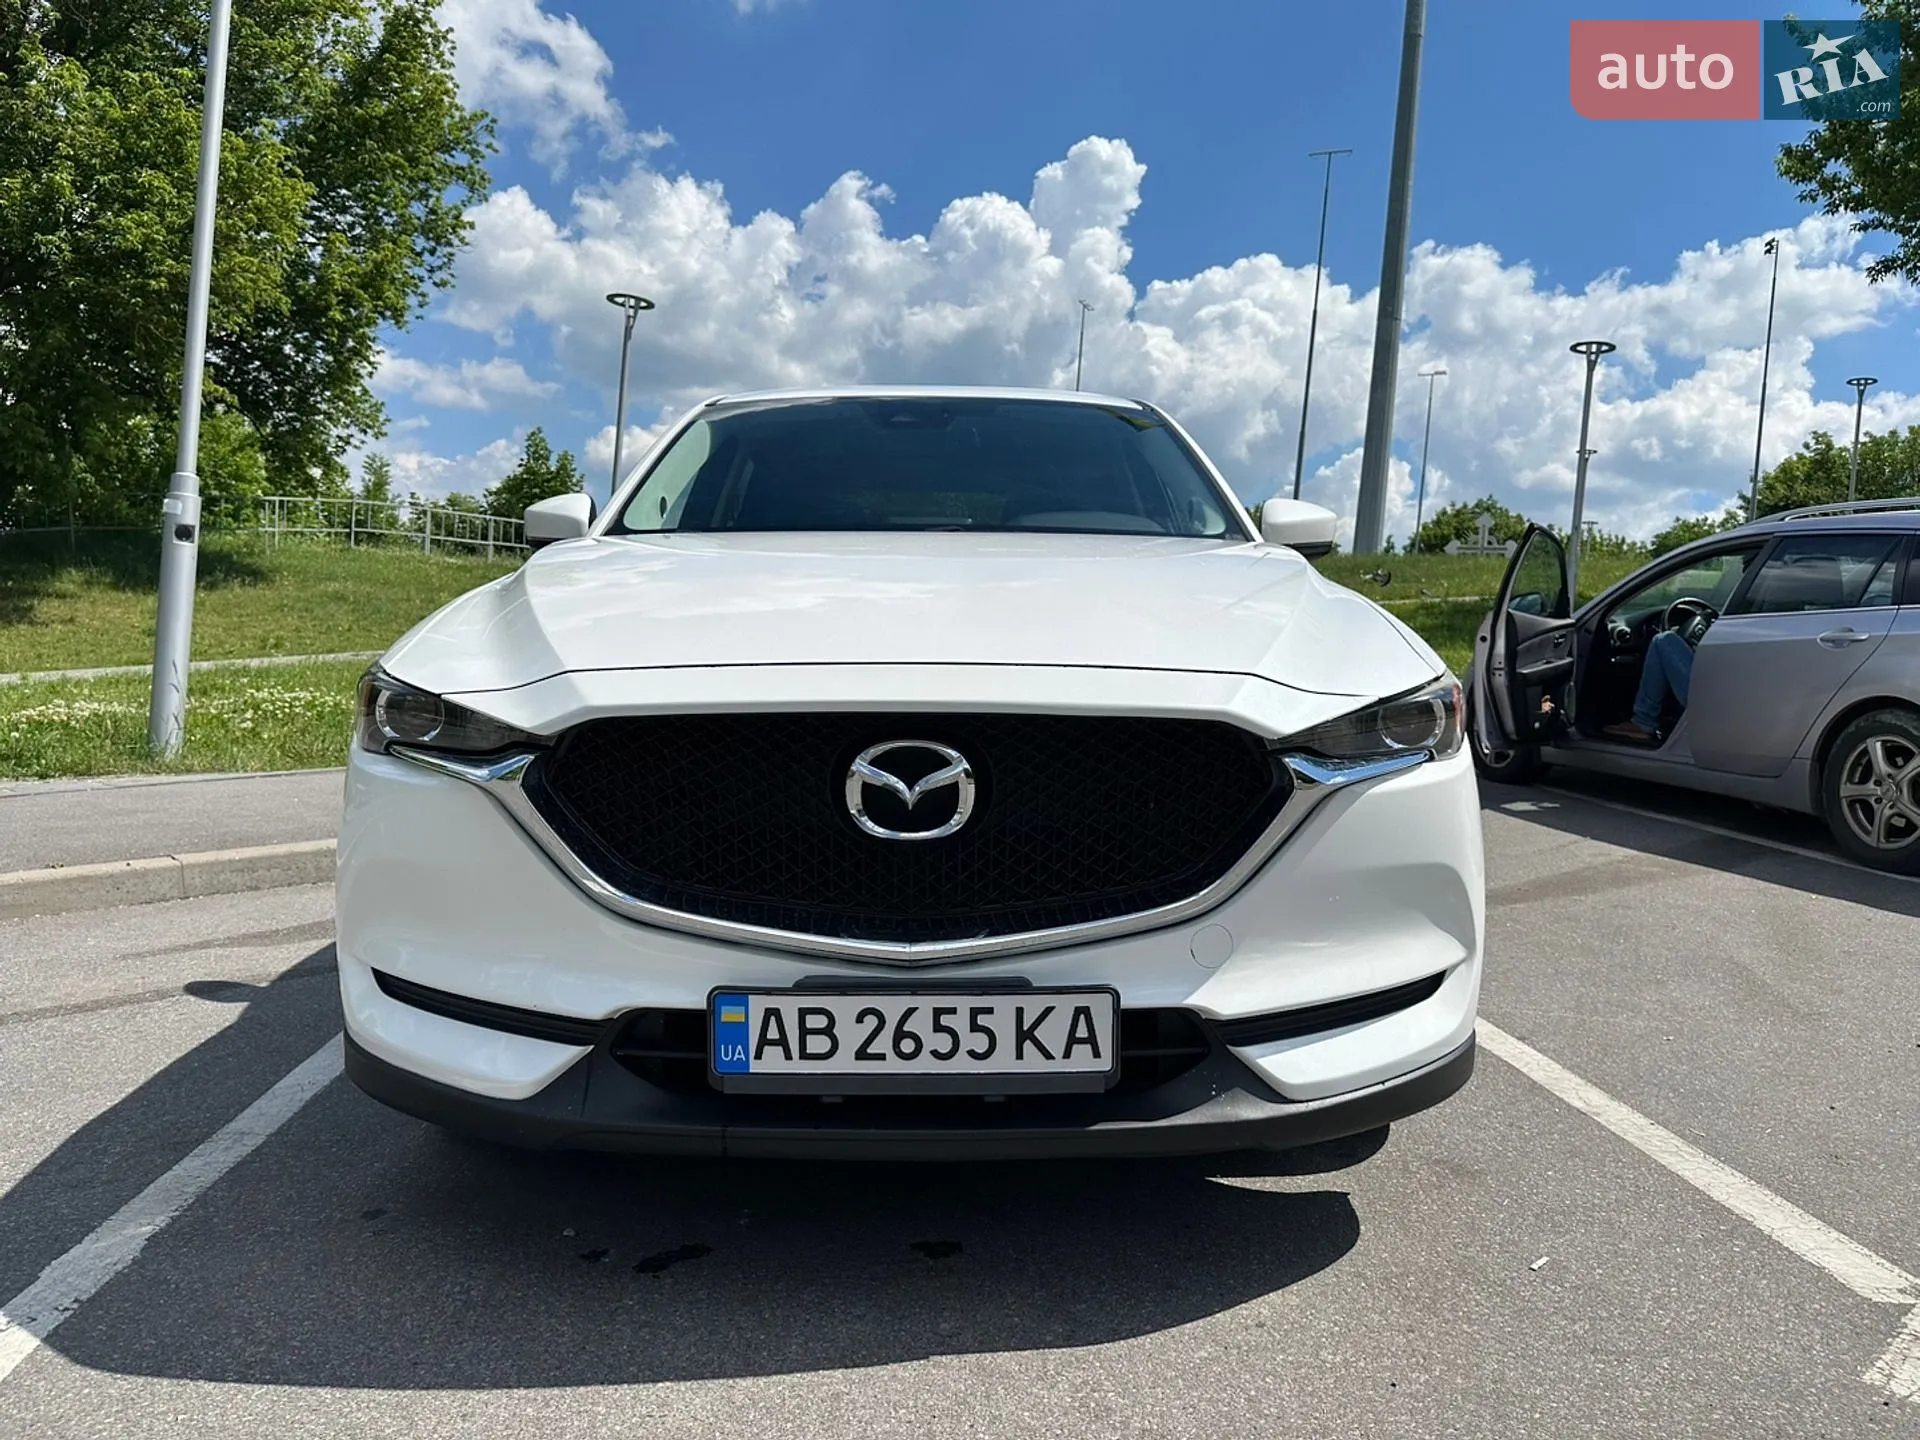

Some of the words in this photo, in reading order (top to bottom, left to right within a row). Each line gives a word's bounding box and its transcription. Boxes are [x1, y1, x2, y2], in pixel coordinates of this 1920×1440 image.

[753, 1006, 840, 1061] AB
[854, 1006, 998, 1061] 2655
[1014, 1005, 1102, 1061] KA
[720, 1043, 747, 1062] UA
